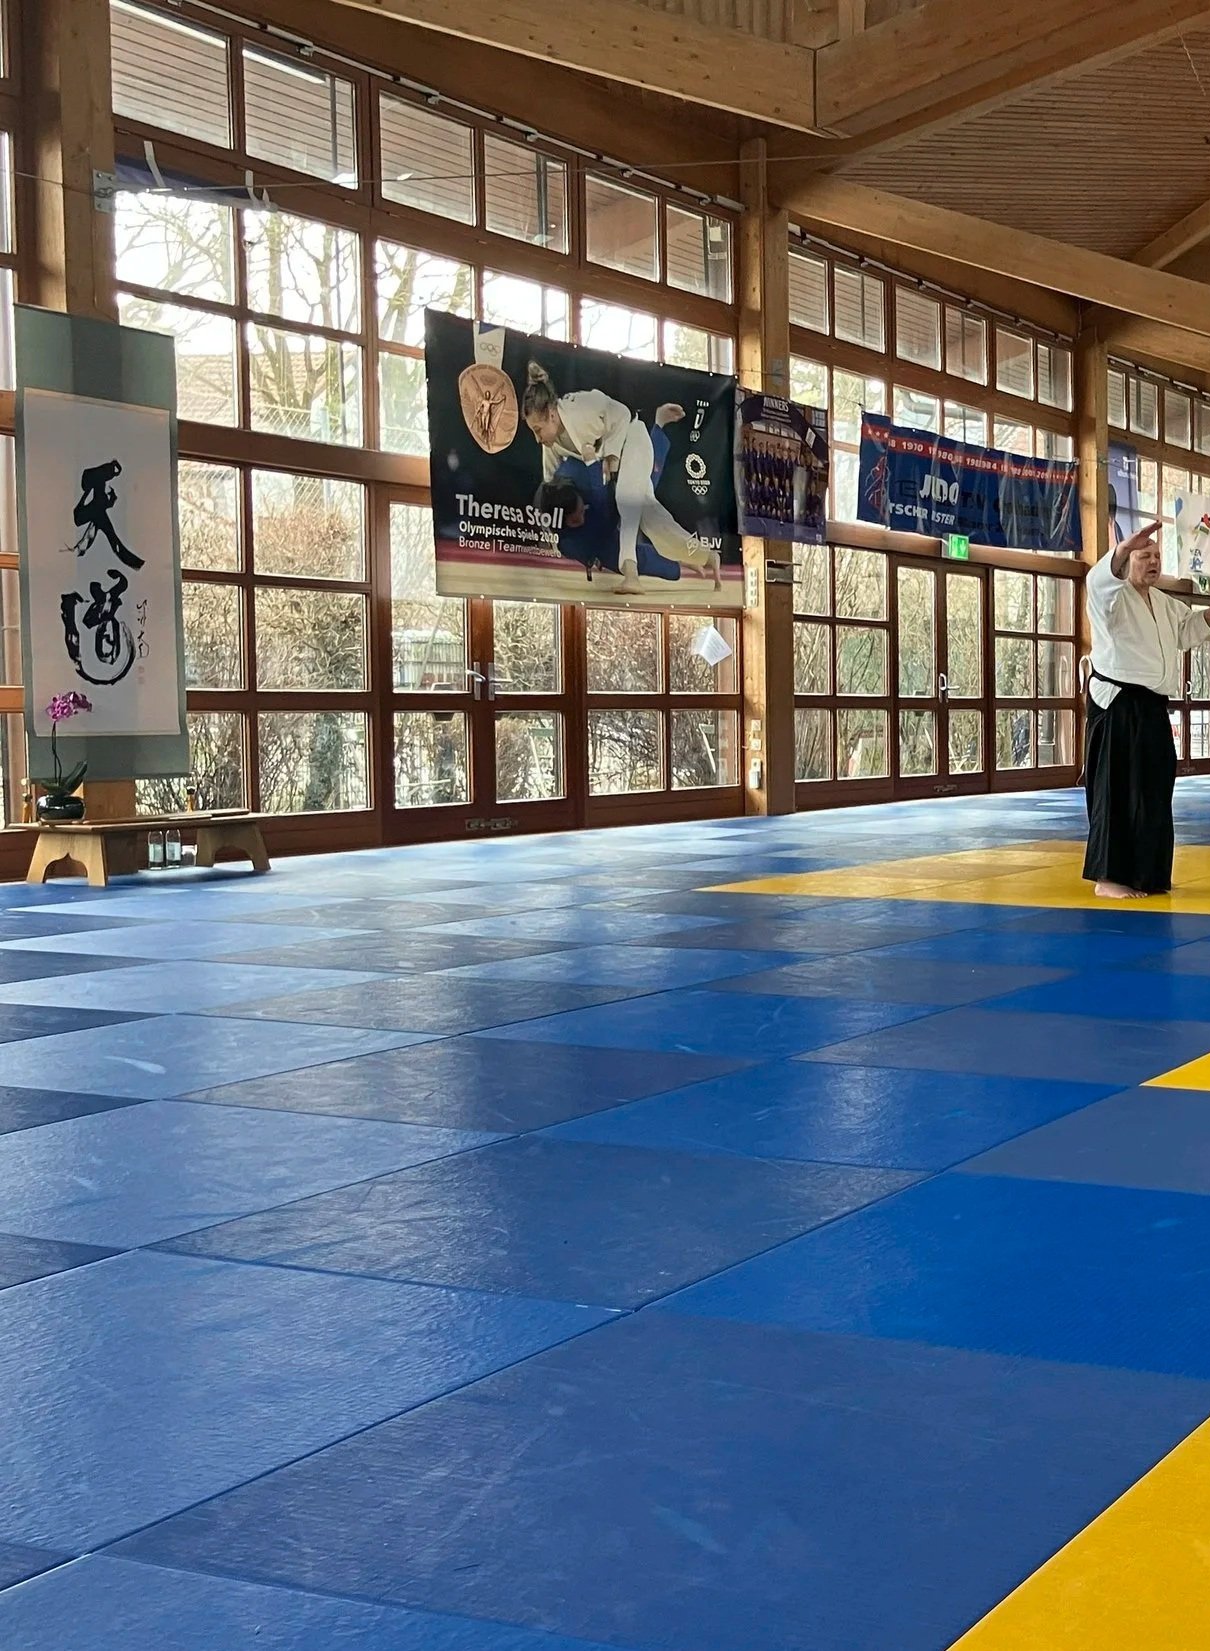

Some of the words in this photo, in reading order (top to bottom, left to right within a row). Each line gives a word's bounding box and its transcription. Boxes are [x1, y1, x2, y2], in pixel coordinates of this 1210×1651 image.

[455, 493, 524, 523] Theresa
[525, 504, 564, 529] Stoll
[459, 521, 516, 538] Olympische
[517, 527, 539, 542] Spiele
[540, 531, 559, 544] 2020
[459, 535, 491, 550] Bronze
[700, 536, 722, 549] BJV
